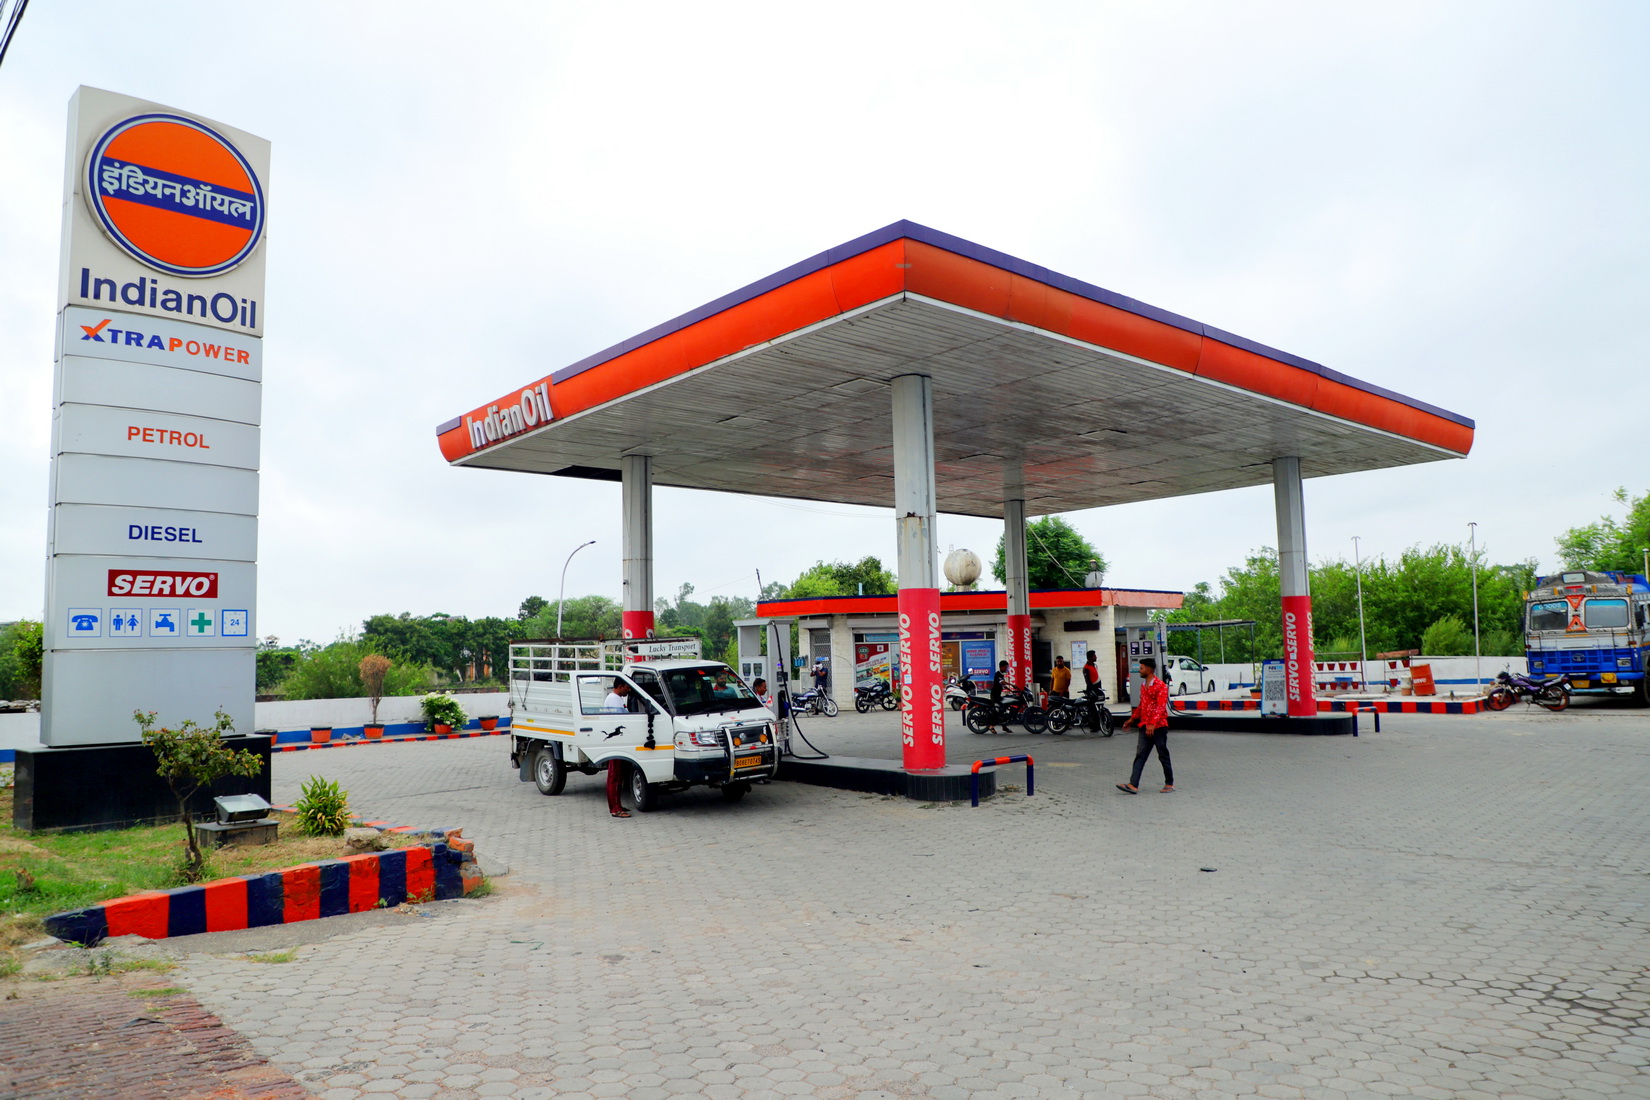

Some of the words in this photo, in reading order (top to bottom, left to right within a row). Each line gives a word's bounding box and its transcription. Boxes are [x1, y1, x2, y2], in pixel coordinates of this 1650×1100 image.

[102, 162, 253, 220] इंडियनऑयल
[80, 267, 256, 328] IndianOil
[127, 426, 210, 449] PETROL
[466, 382, 554, 449] IndianOil
[128, 525, 203, 543] DIESEL
[649, 644, 666, 653] Lucky
[668, 643, 696, 652] Transport
[899, 613, 912, 674] SERVO
[928, 612, 941, 673] SERVO
[1285, 612, 1298, 654] SERVO
[1288, 660, 1300, 702] SERVO
[902, 685, 914, 747] SERVO
[930, 684, 943, 746] SERVO
